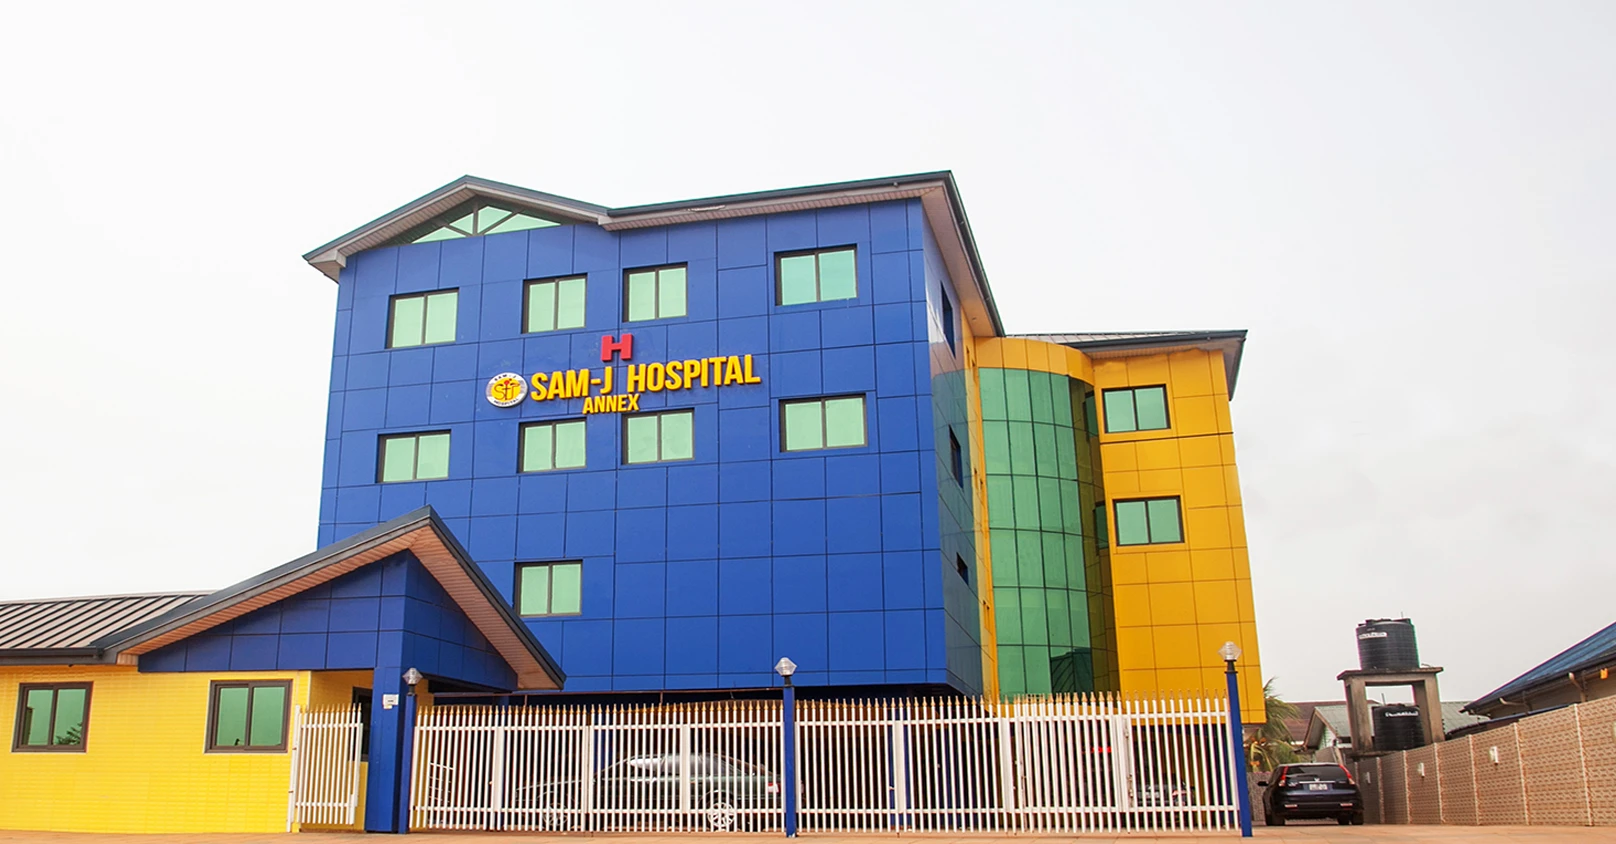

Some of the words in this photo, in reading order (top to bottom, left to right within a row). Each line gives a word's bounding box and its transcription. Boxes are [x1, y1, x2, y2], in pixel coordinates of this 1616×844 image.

[601, 333, 633, 361] H
[530, 366, 613, 401] SAM-J
[627, 354, 761, 393] HOSPITAL
[582, 394, 640, 415] ANNEX
